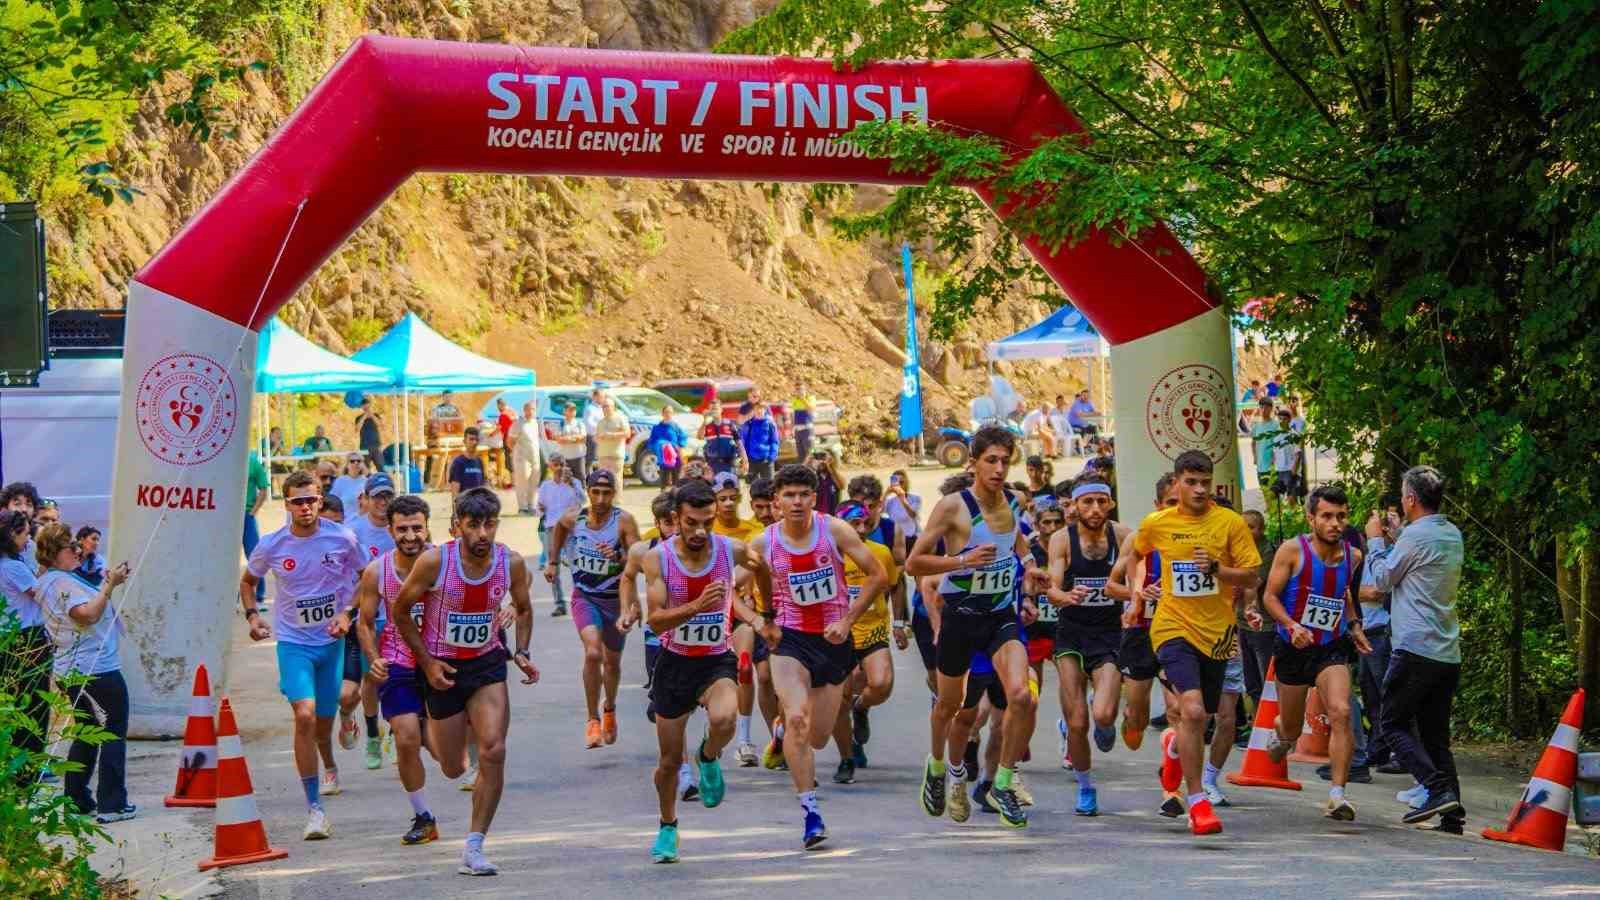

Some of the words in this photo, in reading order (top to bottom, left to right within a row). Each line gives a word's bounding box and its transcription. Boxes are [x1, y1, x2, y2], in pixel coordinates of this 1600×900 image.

[487, 72, 680, 125] START
[690, 81, 718, 126] /
[739, 80, 928, 128] FINISH
[487, 124, 574, 150] KOCAELİ
[578, 127, 663, 156] GENÇLİK
[680, 133, 704, 153] VE
[721, 134, 775, 155] SPOR
[781, 131, 797, 156] İL
[137, 484, 216, 509] KOCAEL
[580, 556, 606, 571] 117
[795, 578, 832, 601] 111
[977, 570, 1010, 590] 116
[1176, 573, 1215, 592] 134
[300, 604, 334, 623] 106
[1308, 607, 1340, 627] 137
[450, 625, 488, 643] 109
[680, 625, 721, 642] 110
